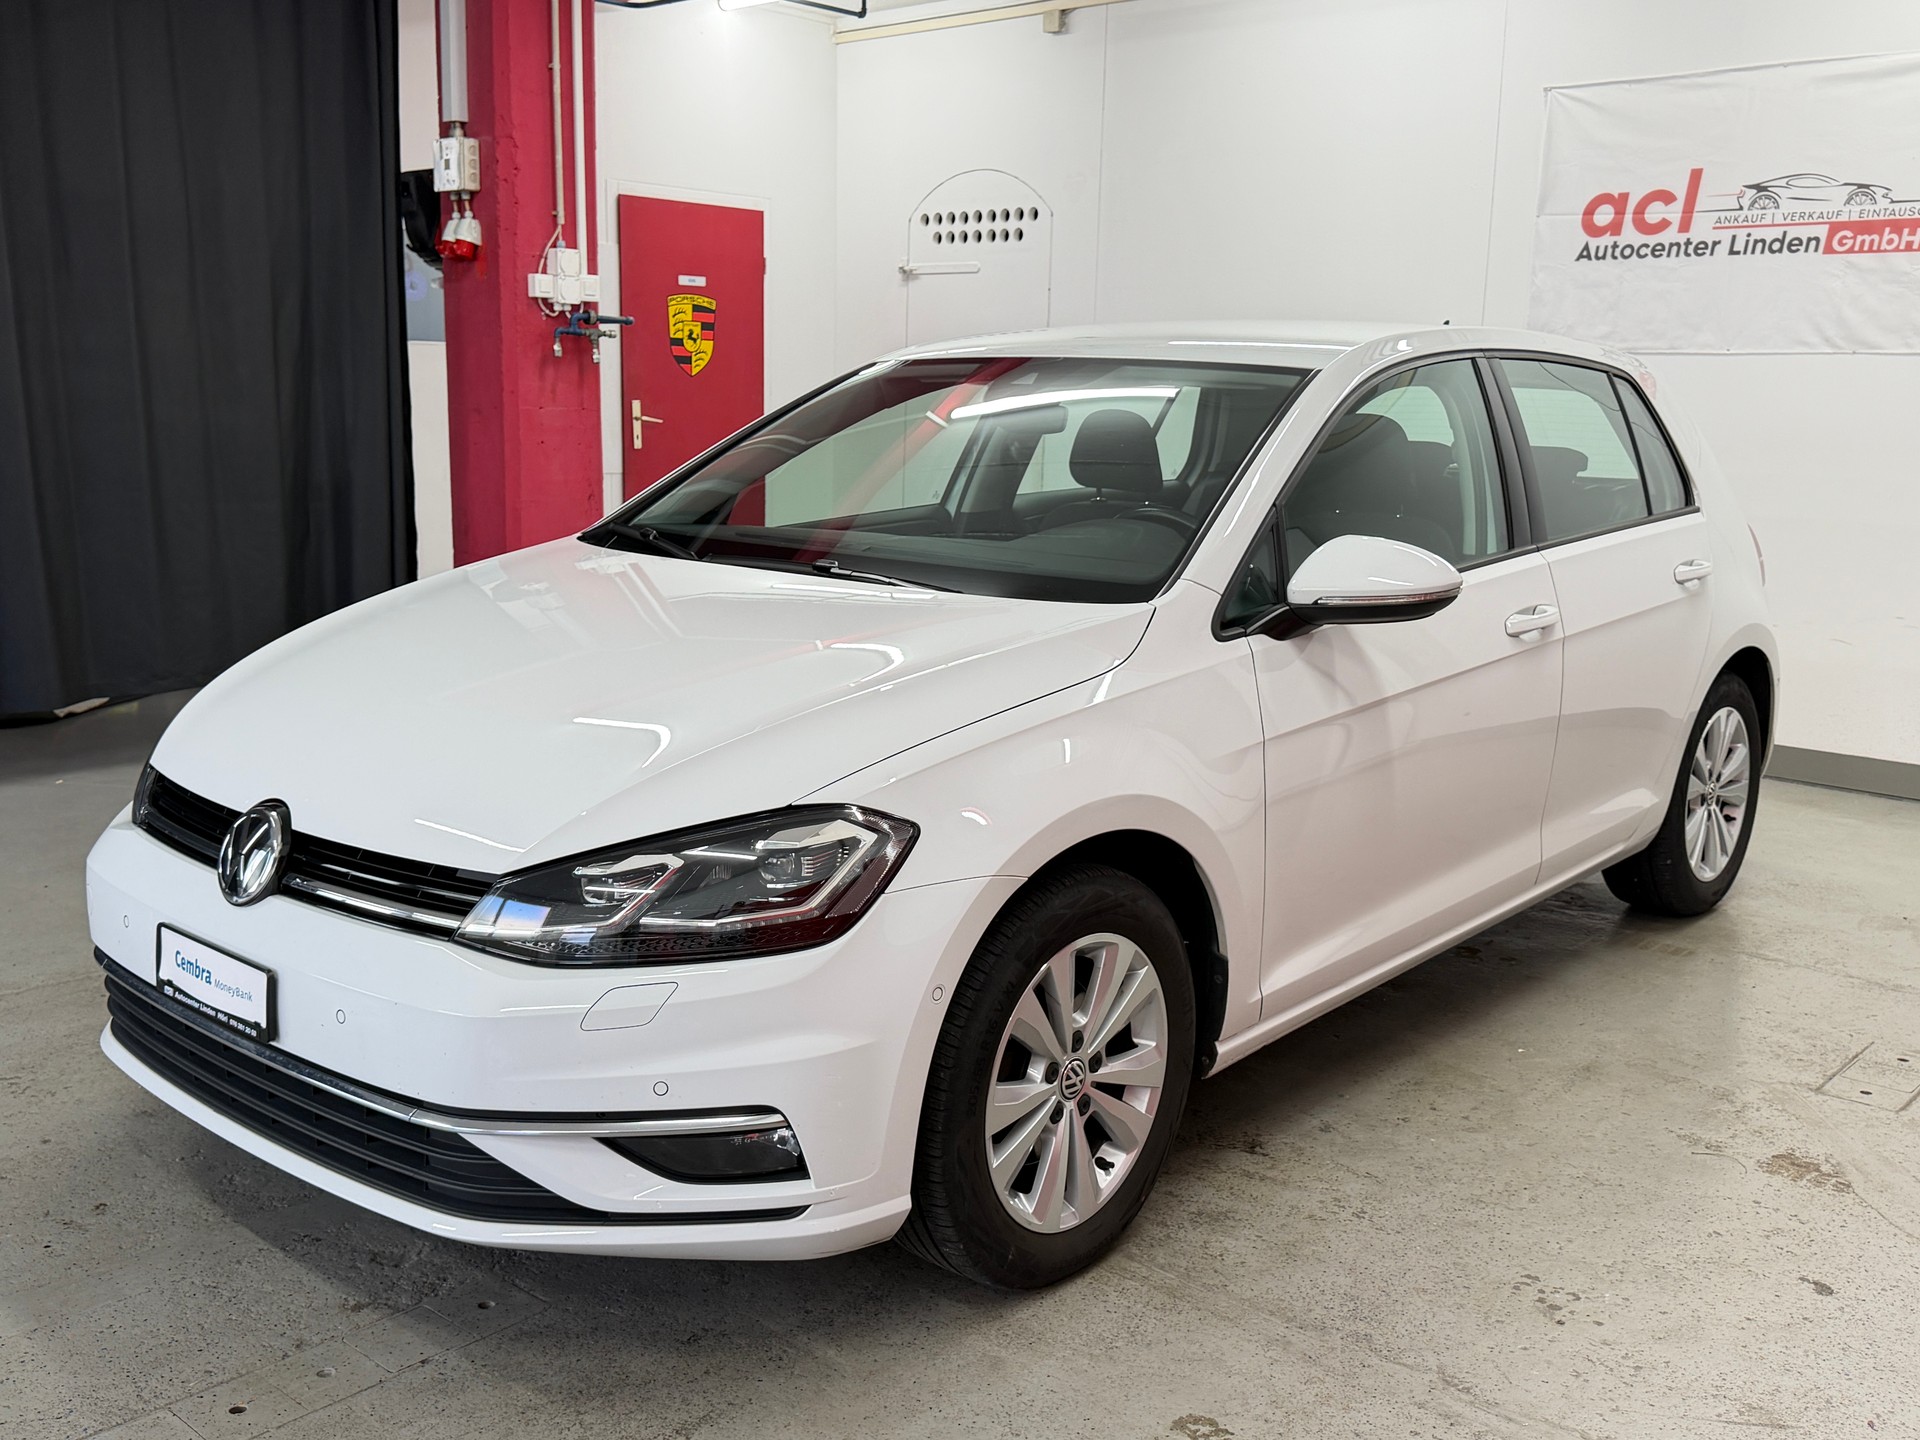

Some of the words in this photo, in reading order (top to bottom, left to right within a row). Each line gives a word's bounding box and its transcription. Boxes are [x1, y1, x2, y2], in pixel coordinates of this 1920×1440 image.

[1580, 167, 1704, 239] acl
[1713, 213, 1768, 226] ANKAUF
[1781, 209, 1844, 223] VERKAUF
[1574, 235, 1721, 262] Autocenter
[1727, 230, 1821, 256] Linden
[1831, 226, 1920, 252] GmbH
[669, 295, 714, 308] PORSCHE
[174, 949, 212, 986] Cembra
[213, 978, 253, 1002] MoneyBank
[174, 990, 200, 1009] Autocenter
[199, 1002, 216, 1017] Linden
